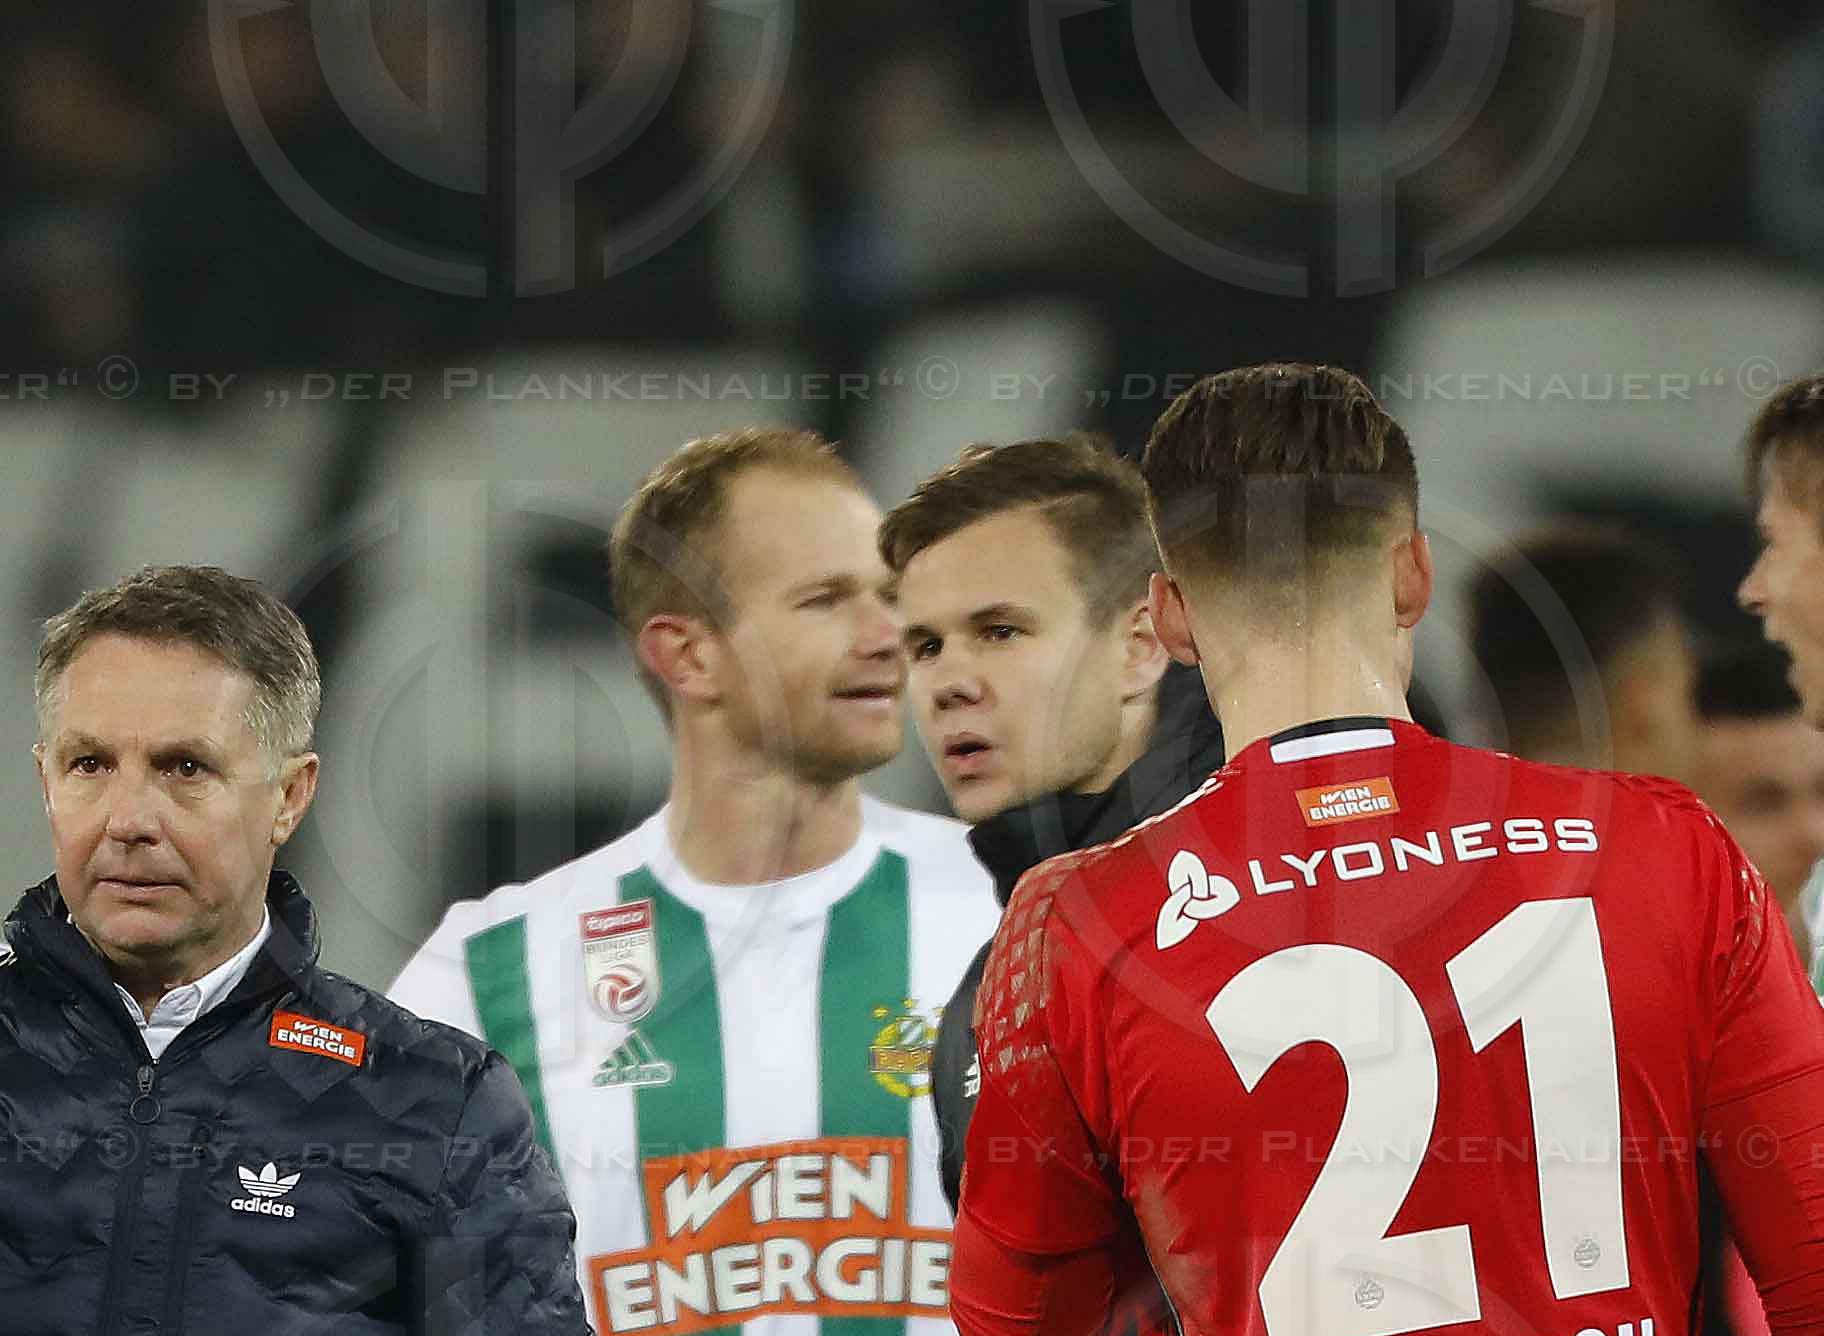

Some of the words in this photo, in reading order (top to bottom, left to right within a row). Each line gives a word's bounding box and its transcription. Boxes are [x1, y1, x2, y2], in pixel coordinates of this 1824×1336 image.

[1320, 785, 1372, 803] WIEN
[1308, 796, 1392, 821] ENERGIE
[1248, 817, 1600, 896] LYONESS
[277, 1028, 356, 1059] ENERGIE
[294, 1020, 343, 1042] WIEN
[230, 1196, 296, 1219] adidas
[662, 1152, 893, 1240] WIEN
[603, 1235, 952, 1336] ENERGIE
